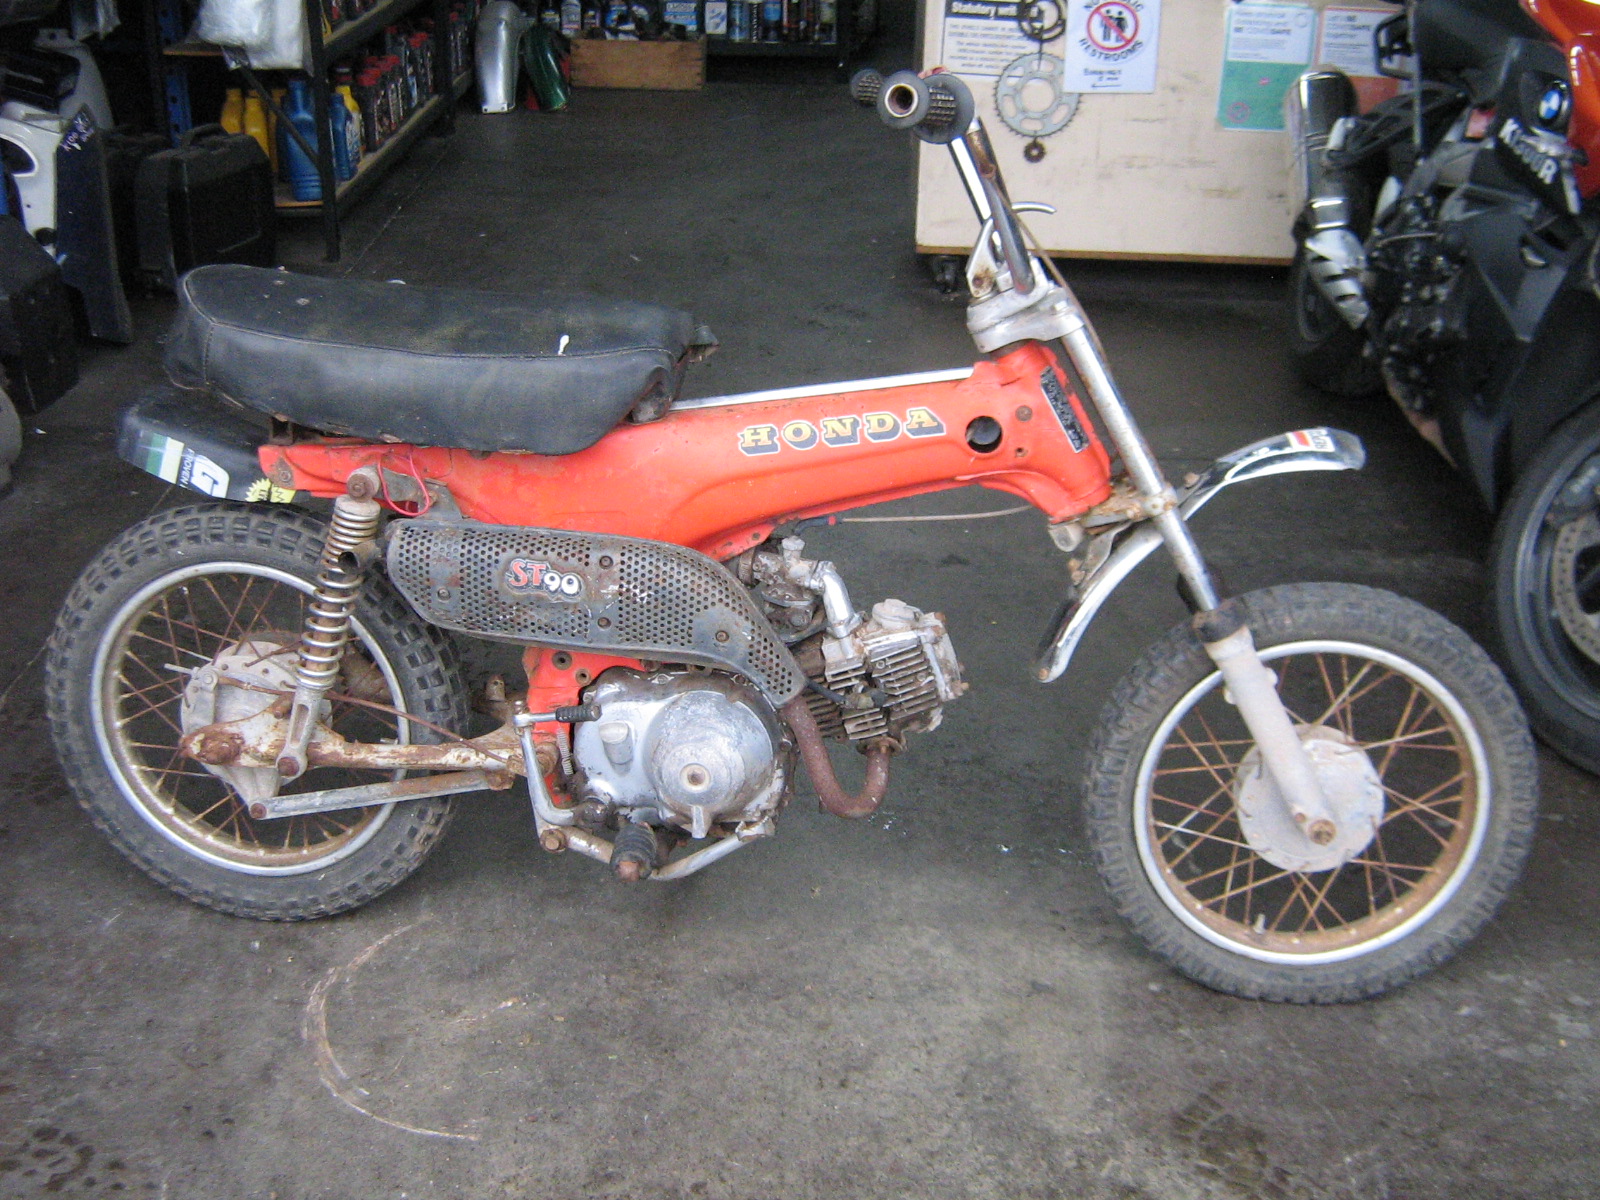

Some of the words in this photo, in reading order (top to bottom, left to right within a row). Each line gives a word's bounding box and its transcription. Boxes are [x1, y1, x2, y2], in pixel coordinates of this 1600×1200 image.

[1079, 38, 1144, 61] RESTROOMS
[738, 407, 946, 456] HONDA
[504, 558, 583, 600] ST90
